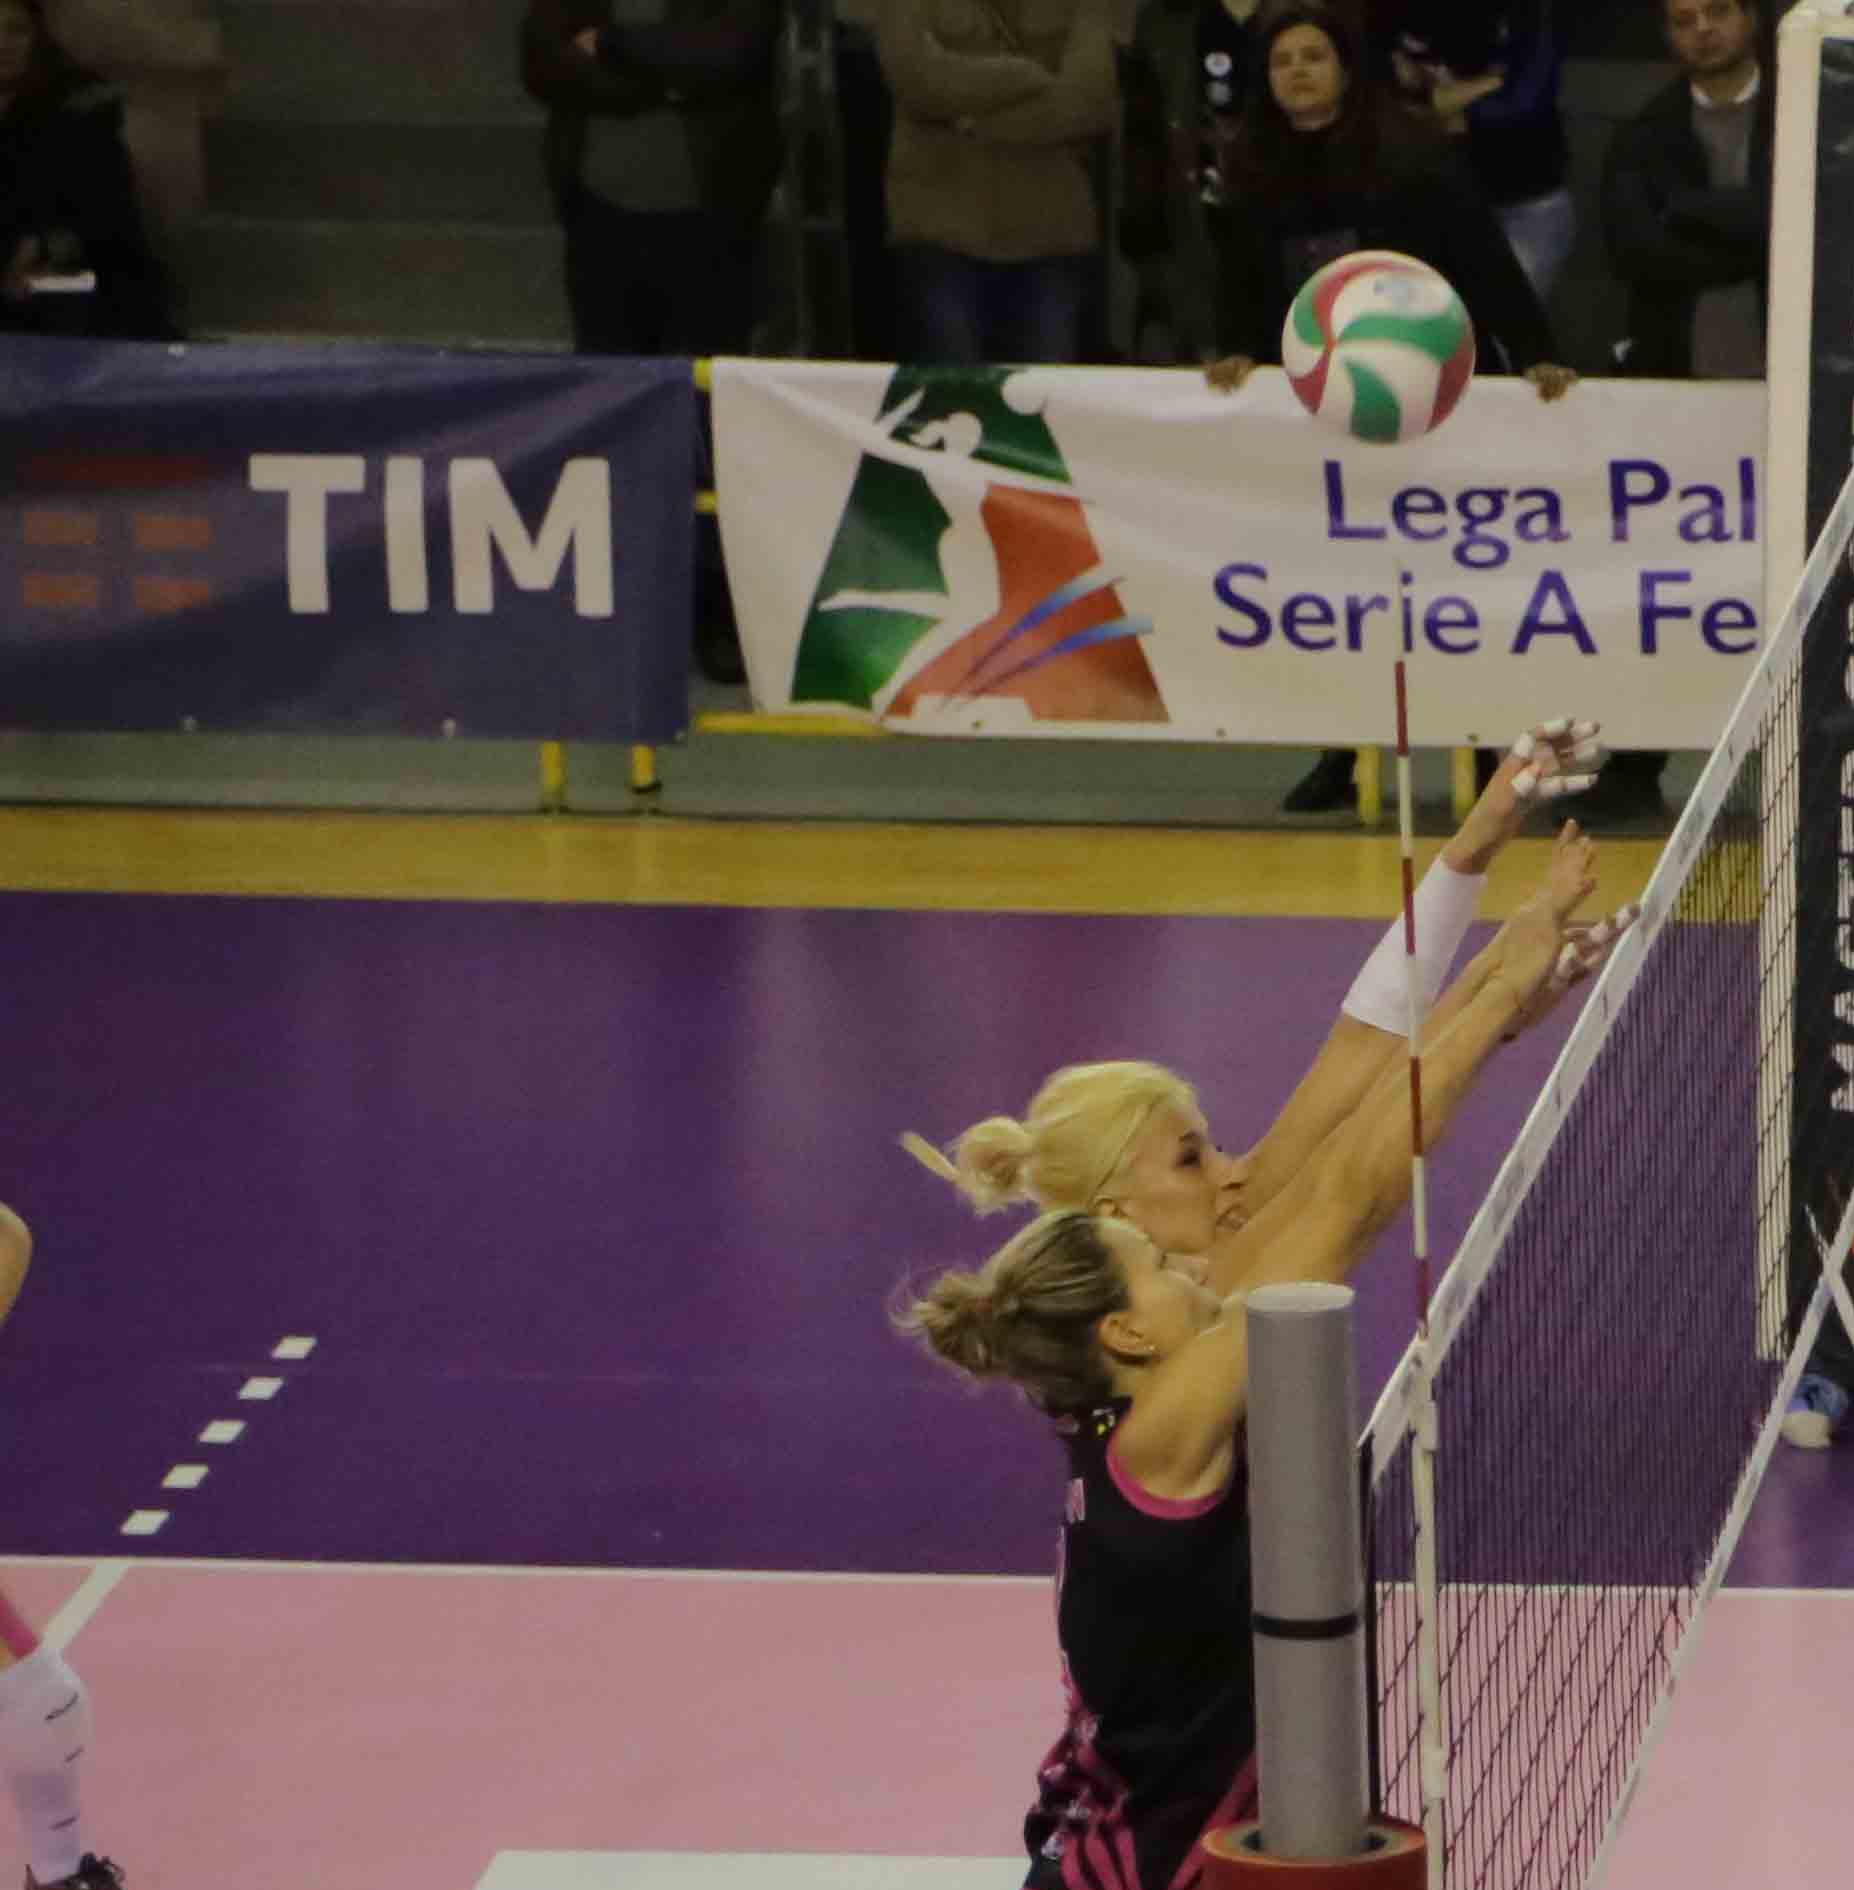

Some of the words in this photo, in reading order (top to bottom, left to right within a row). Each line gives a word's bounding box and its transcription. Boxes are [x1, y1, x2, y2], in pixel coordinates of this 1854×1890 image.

[249, 454, 614, 617] TIM
[1324, 460, 1570, 568] Lega
[1213, 563, 1504, 655] Serie
[1511, 570, 1600, 656] A
